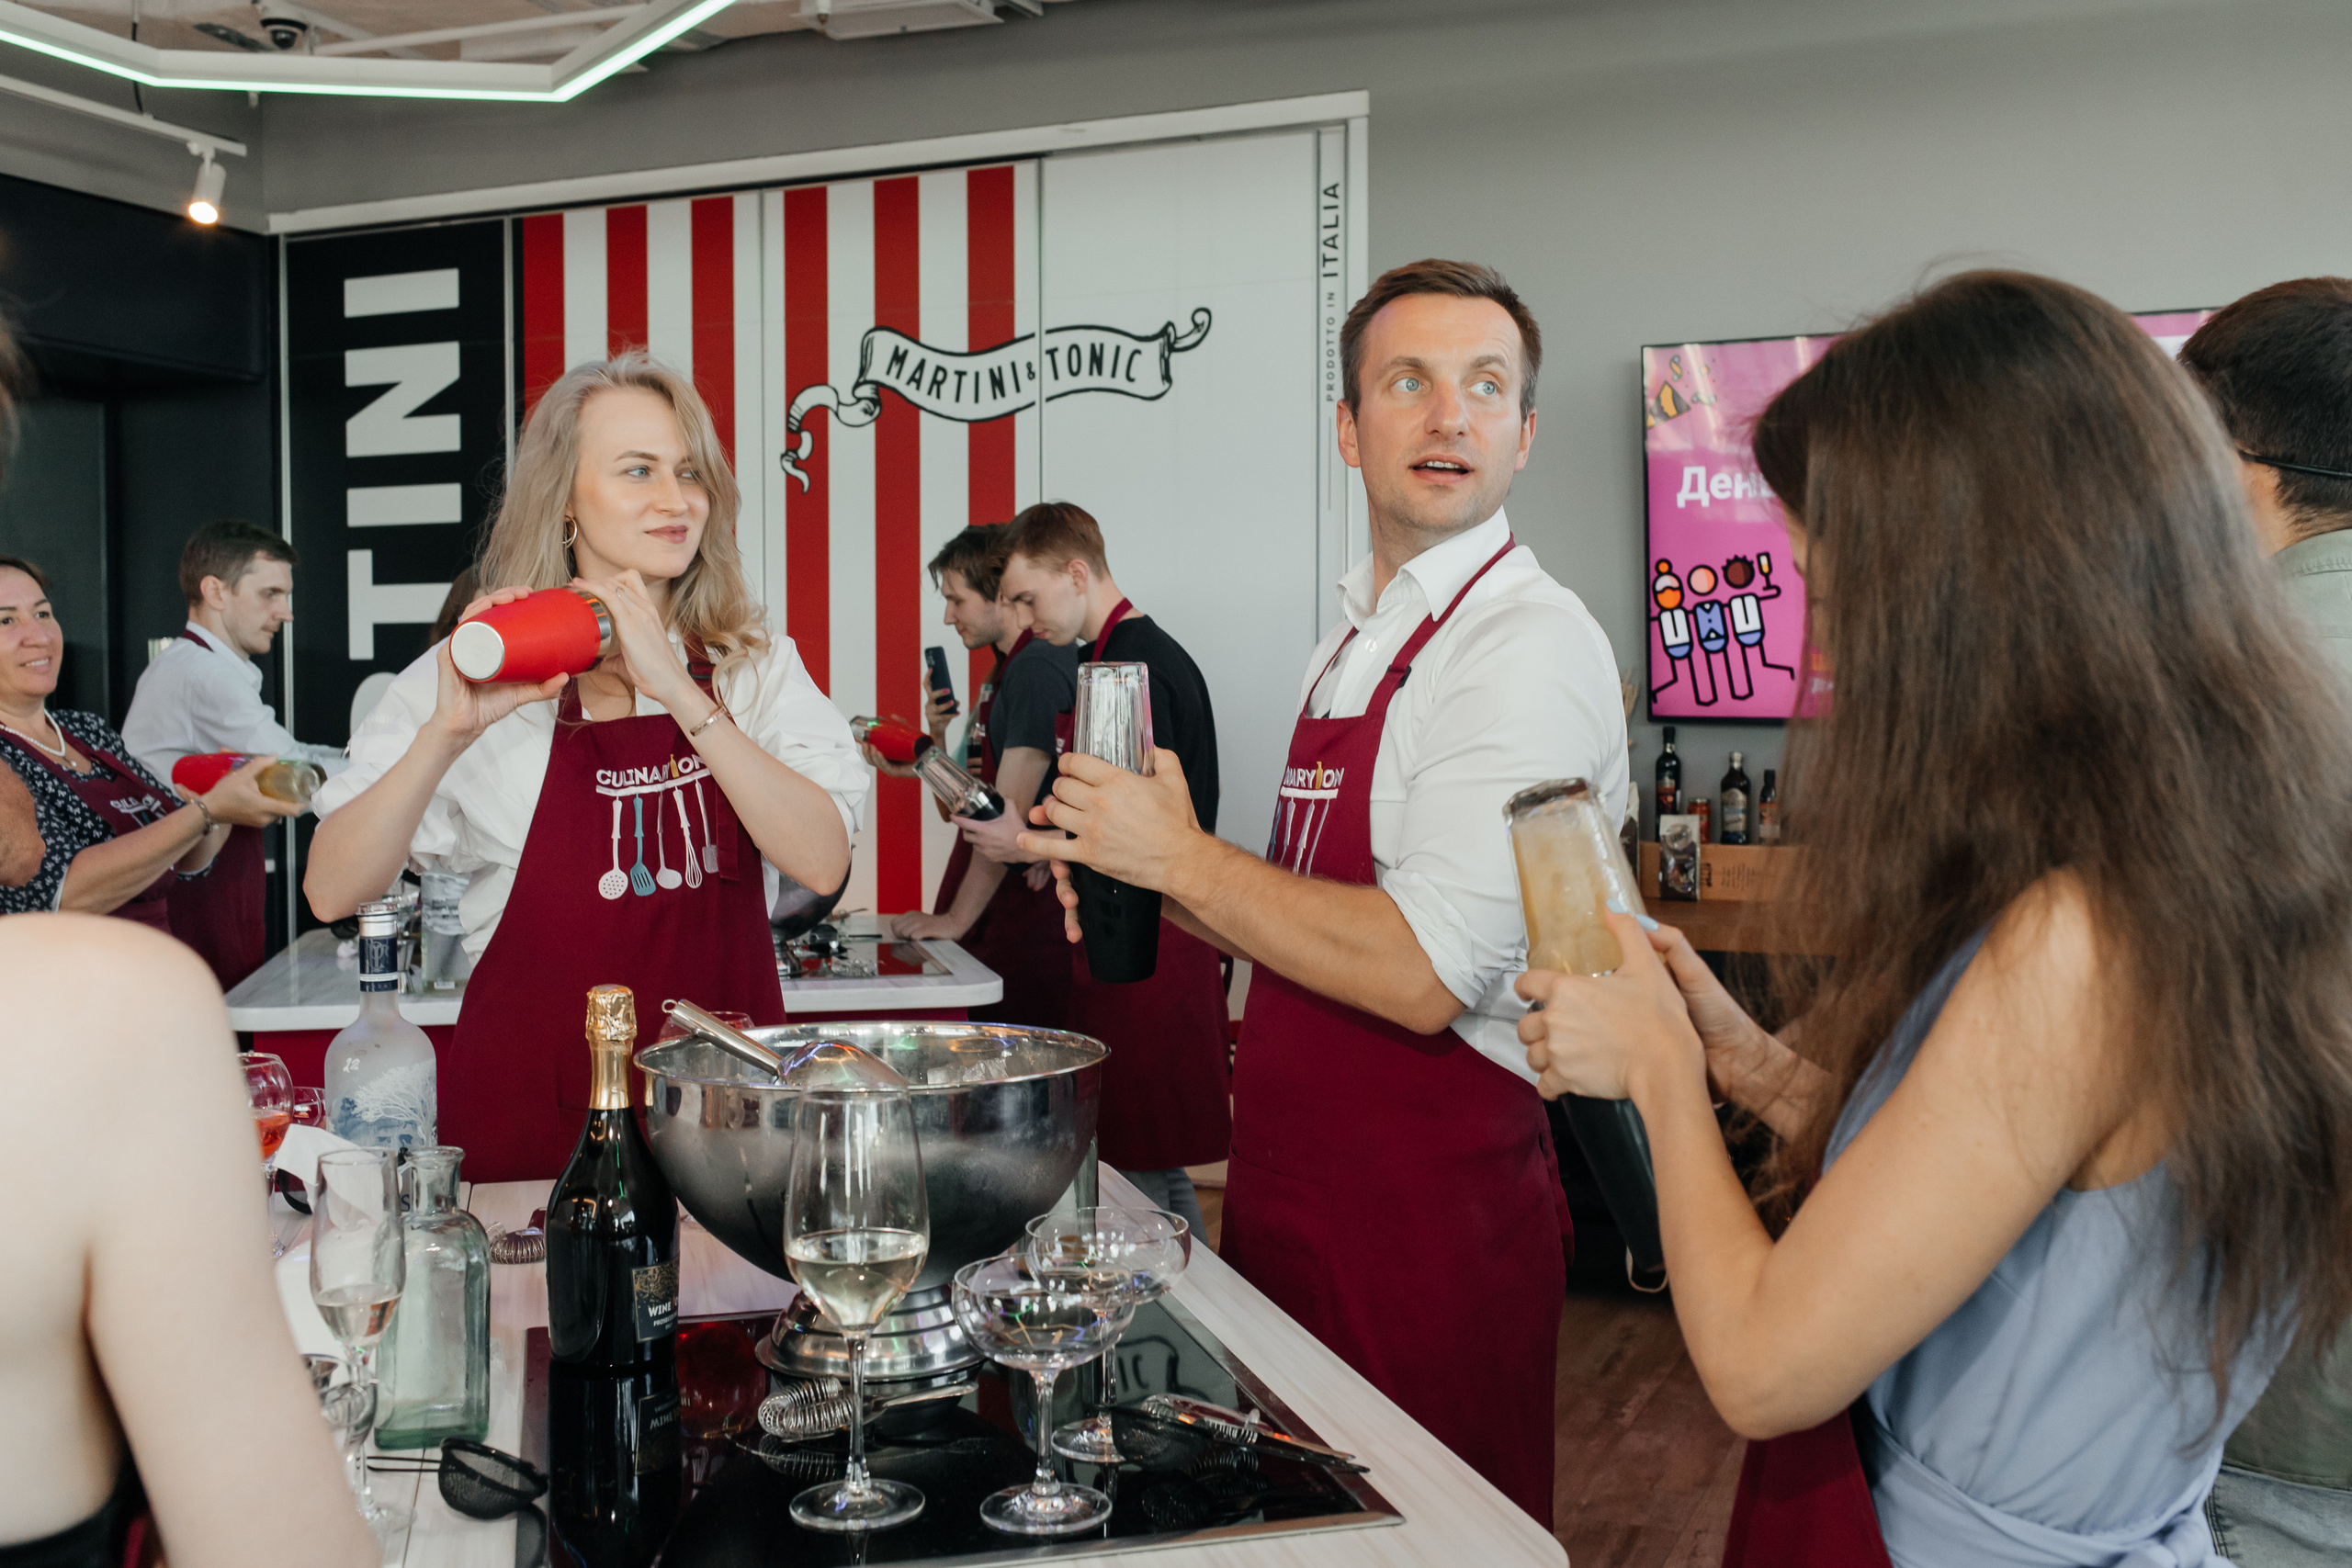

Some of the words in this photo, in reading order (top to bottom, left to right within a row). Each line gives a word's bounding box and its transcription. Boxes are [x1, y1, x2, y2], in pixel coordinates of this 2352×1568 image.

[1322, 183, 1340, 277] ITALIA
[1327, 291, 1336, 308] IN
[886, 344, 1022, 403] MARTINI
[1026, 361, 1036, 380] &
[1046, 343, 1142, 382] TONIC
[1326, 317, 1336, 402] PRODOTTO
[344, 267, 462, 736] TINI
